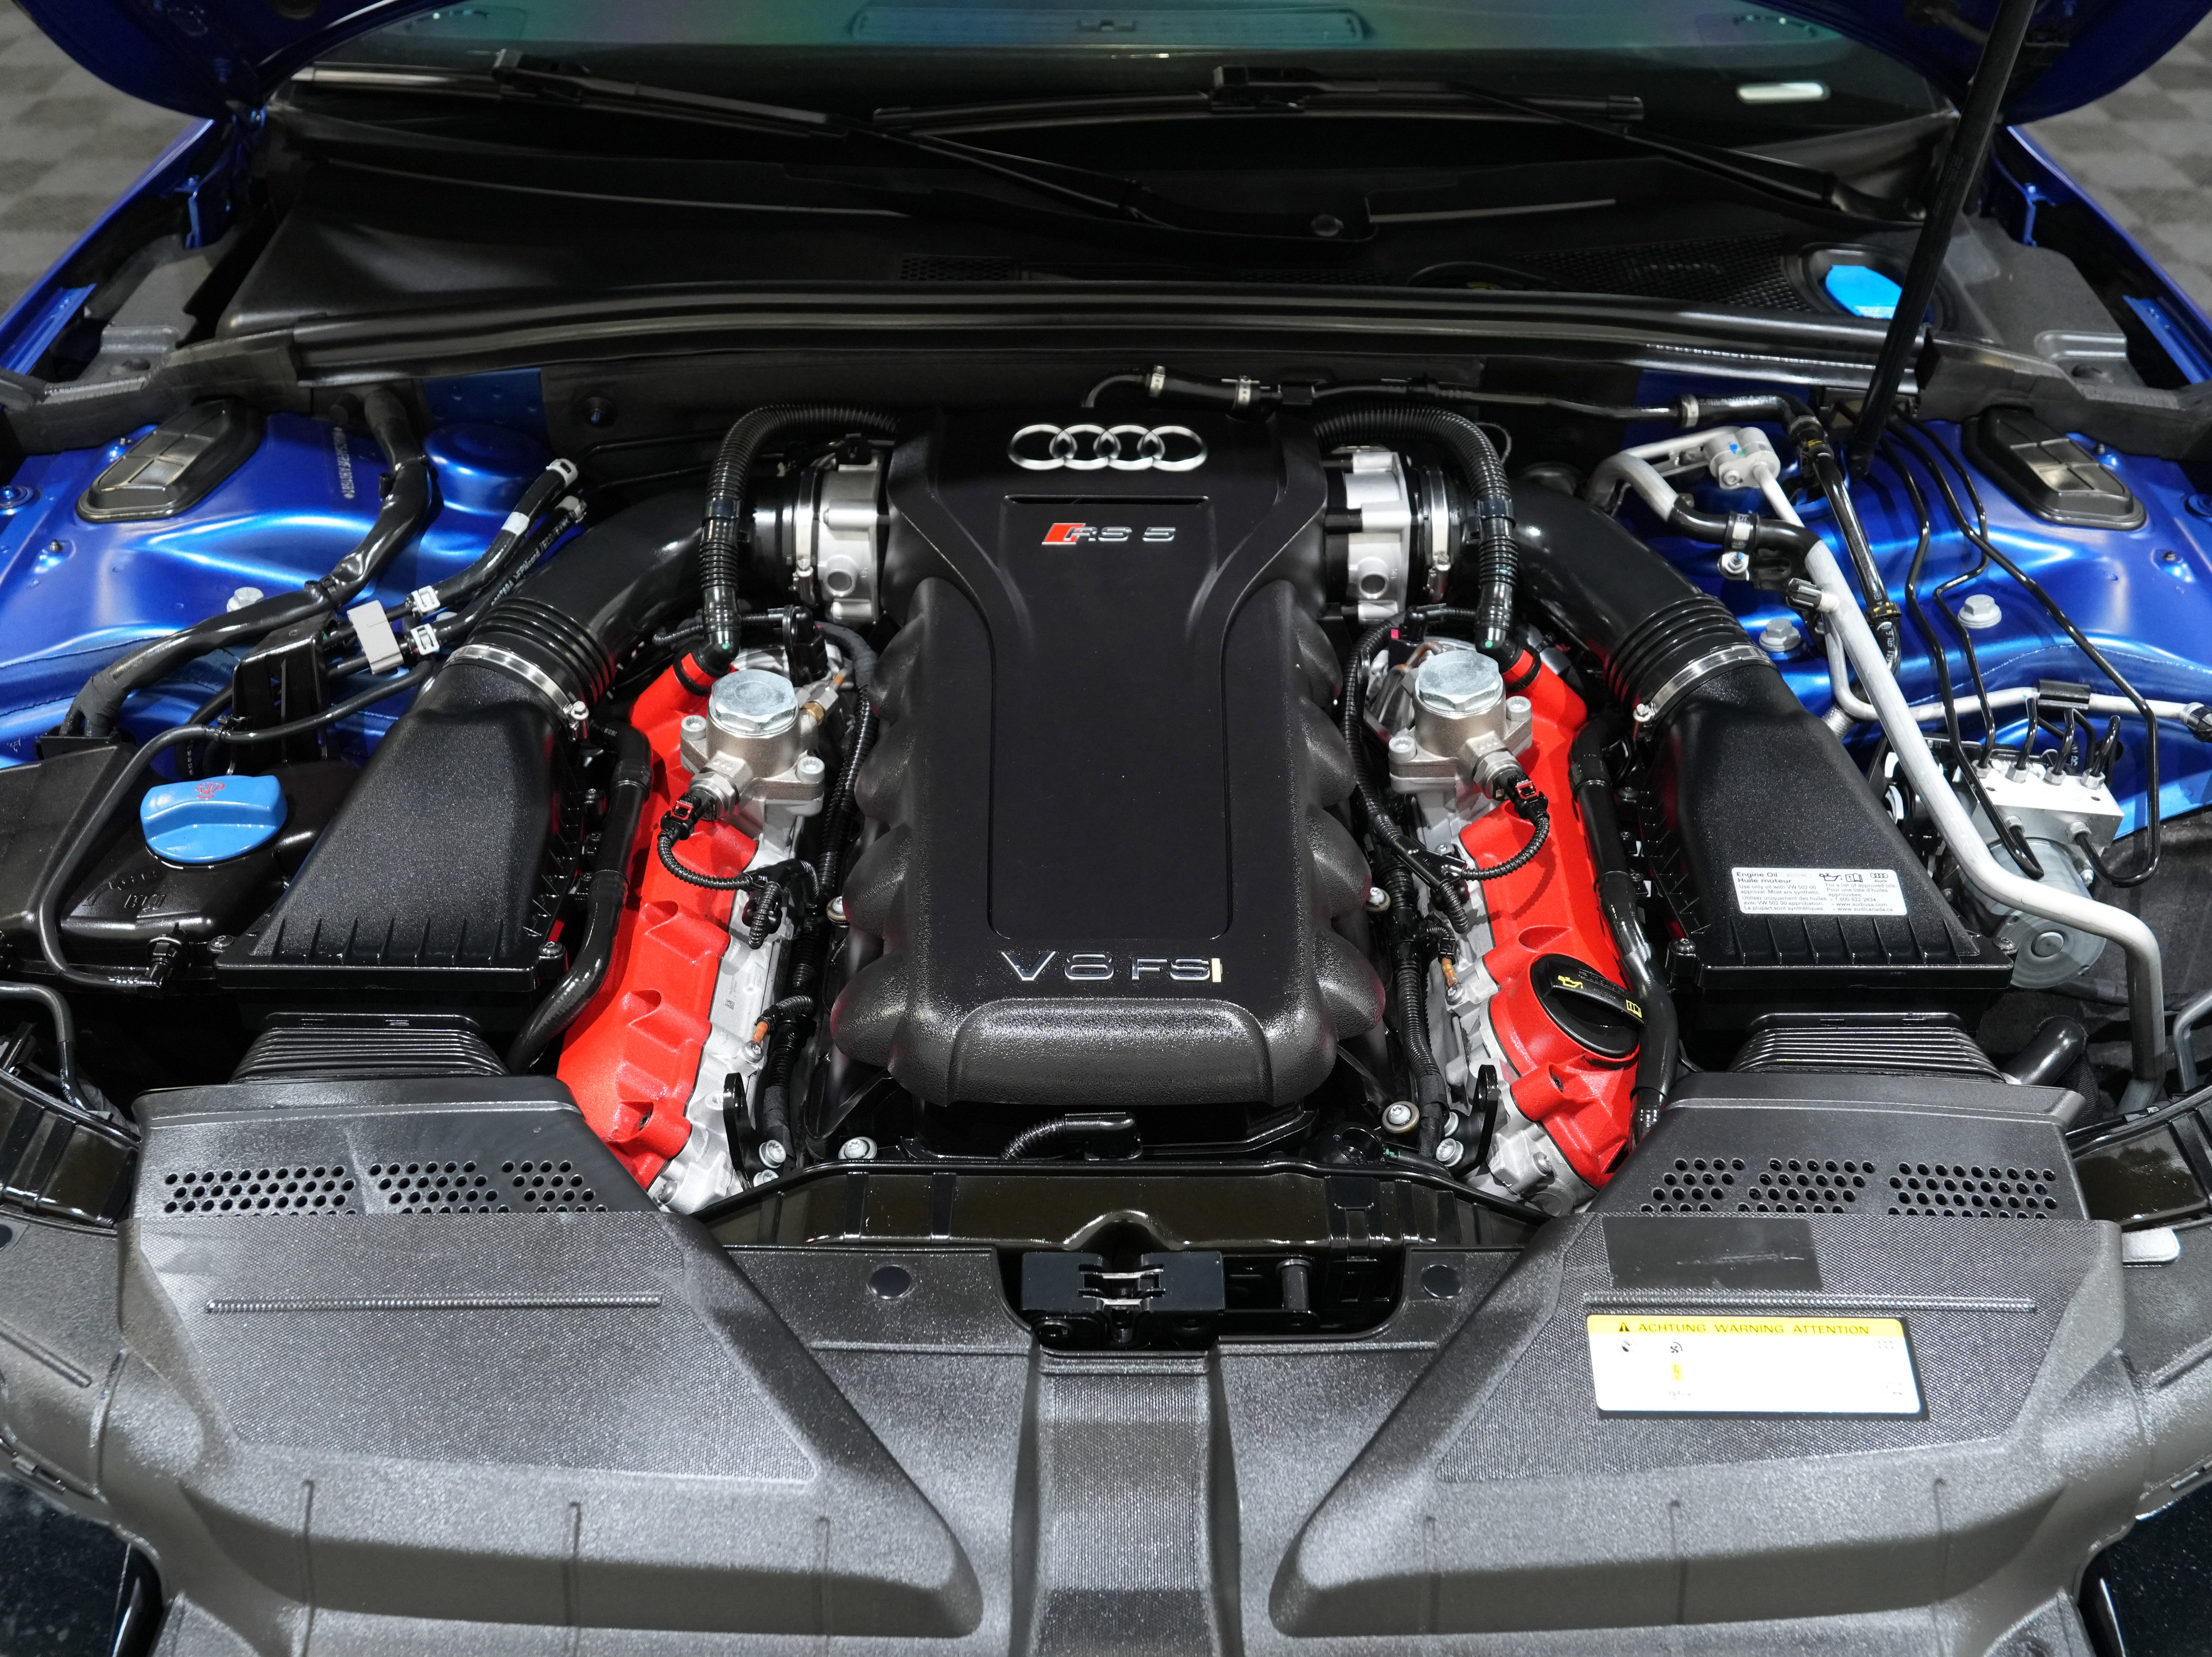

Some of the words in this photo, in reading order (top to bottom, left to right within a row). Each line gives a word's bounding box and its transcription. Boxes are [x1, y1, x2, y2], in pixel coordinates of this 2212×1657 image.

[1061, 525, 1132, 543] RS
[1142, 527, 1176, 542] 5
[1001, 951, 1114, 981] V8
[1131, 958, 1222, 983] FSI
[1638, 1324, 1706, 1332] ACHTUNG
[1714, 1324, 1784, 1333] WARNING
[1793, 1325, 1869, 1334] ATTENTION
